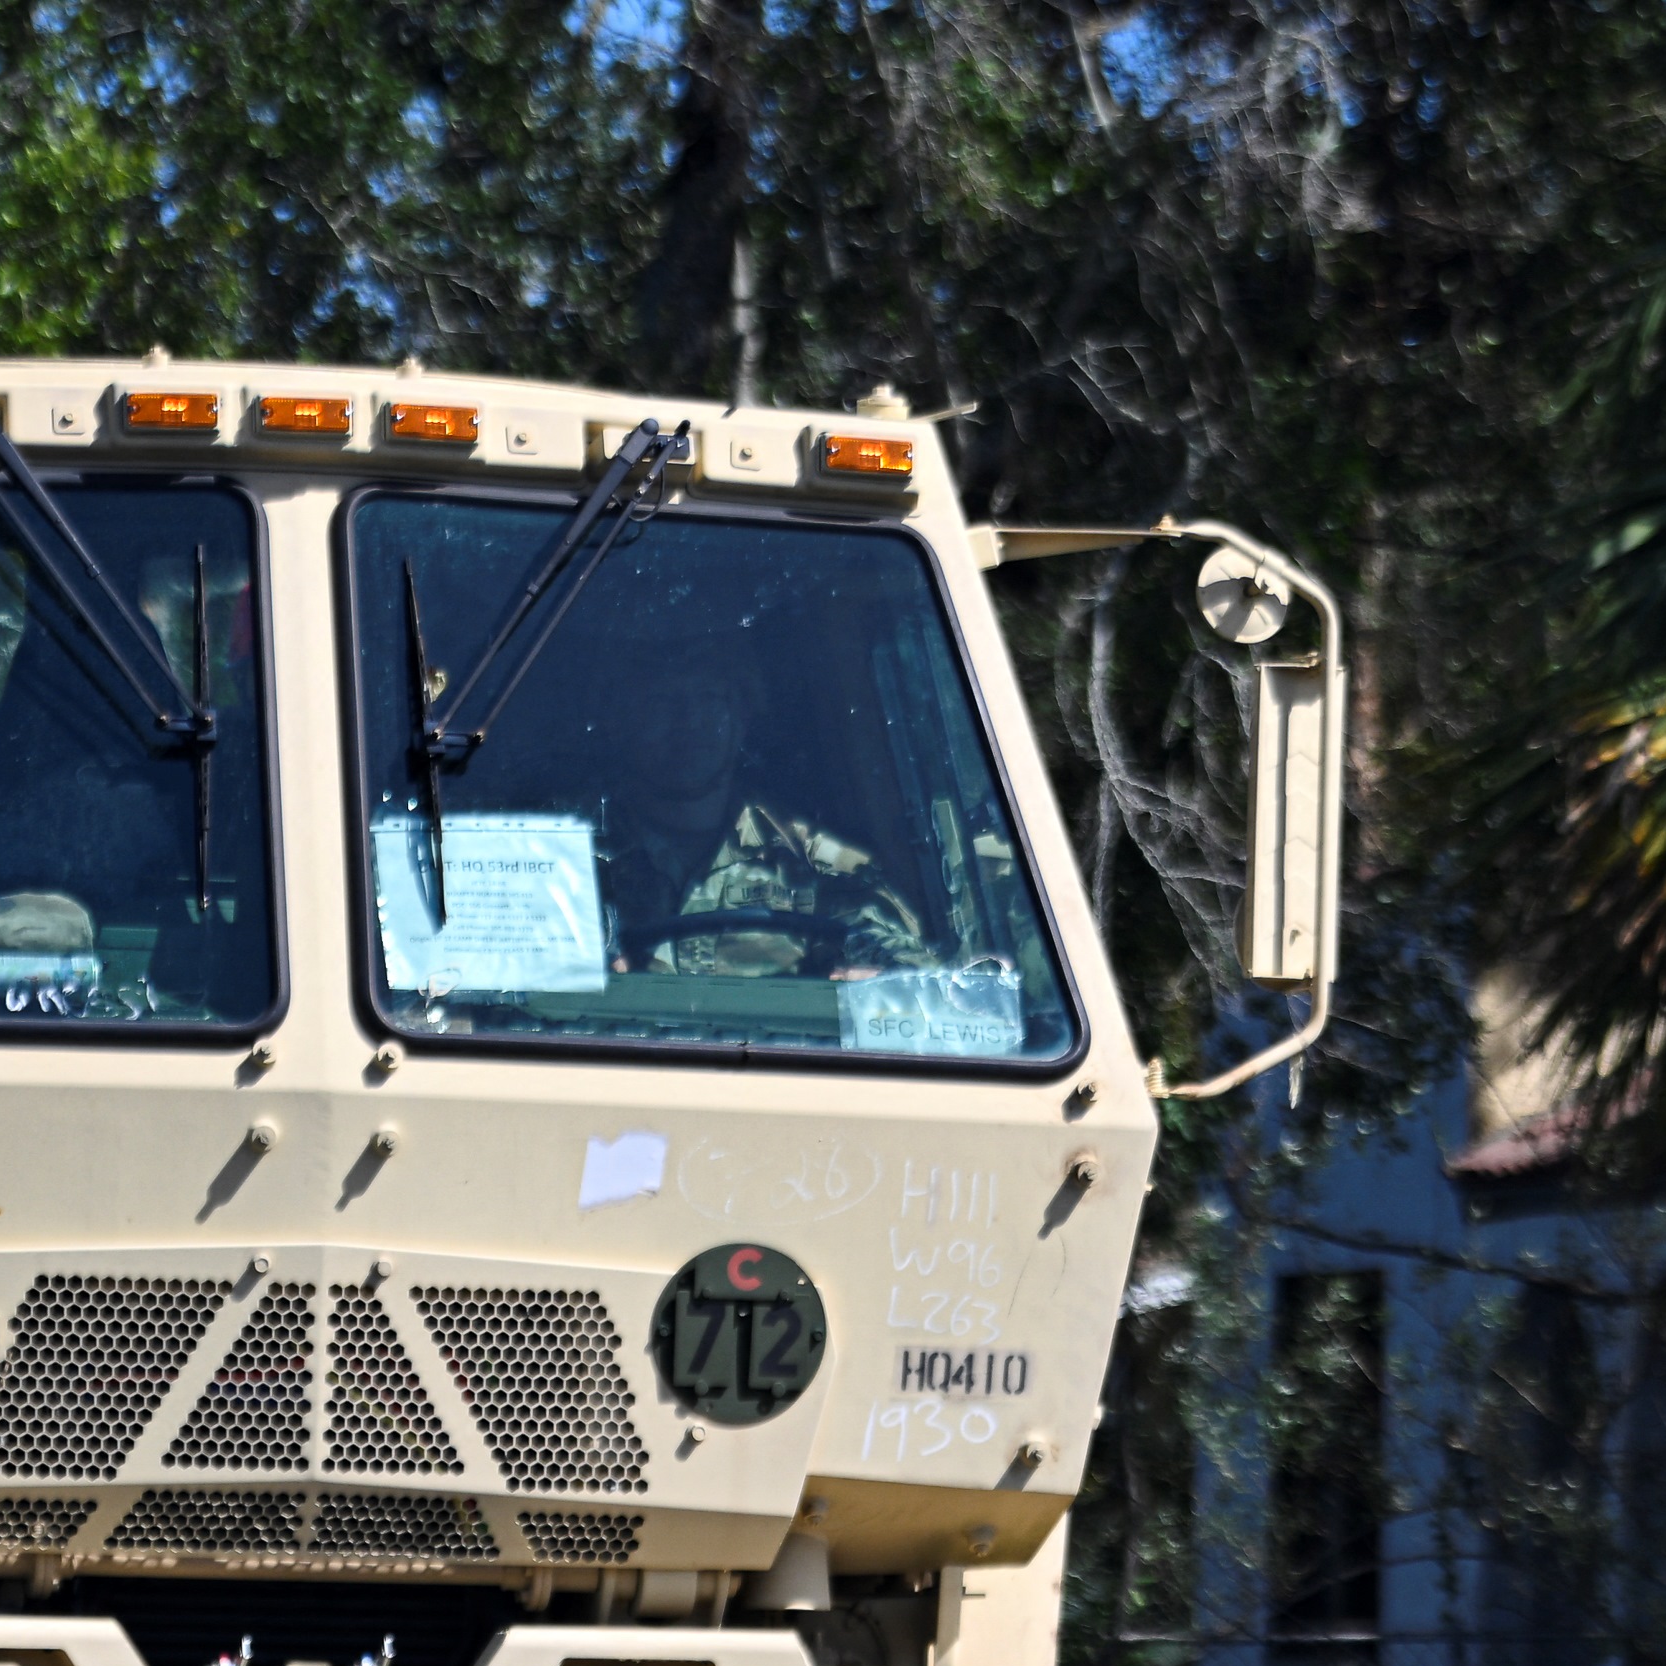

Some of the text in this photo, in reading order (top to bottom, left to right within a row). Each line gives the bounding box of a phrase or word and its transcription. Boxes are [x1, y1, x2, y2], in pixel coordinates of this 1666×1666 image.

[461, 861, 484, 874] HQ
[488, 861, 519, 873] 53rd
[523, 861, 555, 874] IBCT
[867, 1017, 1002, 1045] SFC LEWIS
[726, 1247, 764, 1293] C
[860, 1396, 999, 1462] 1930
